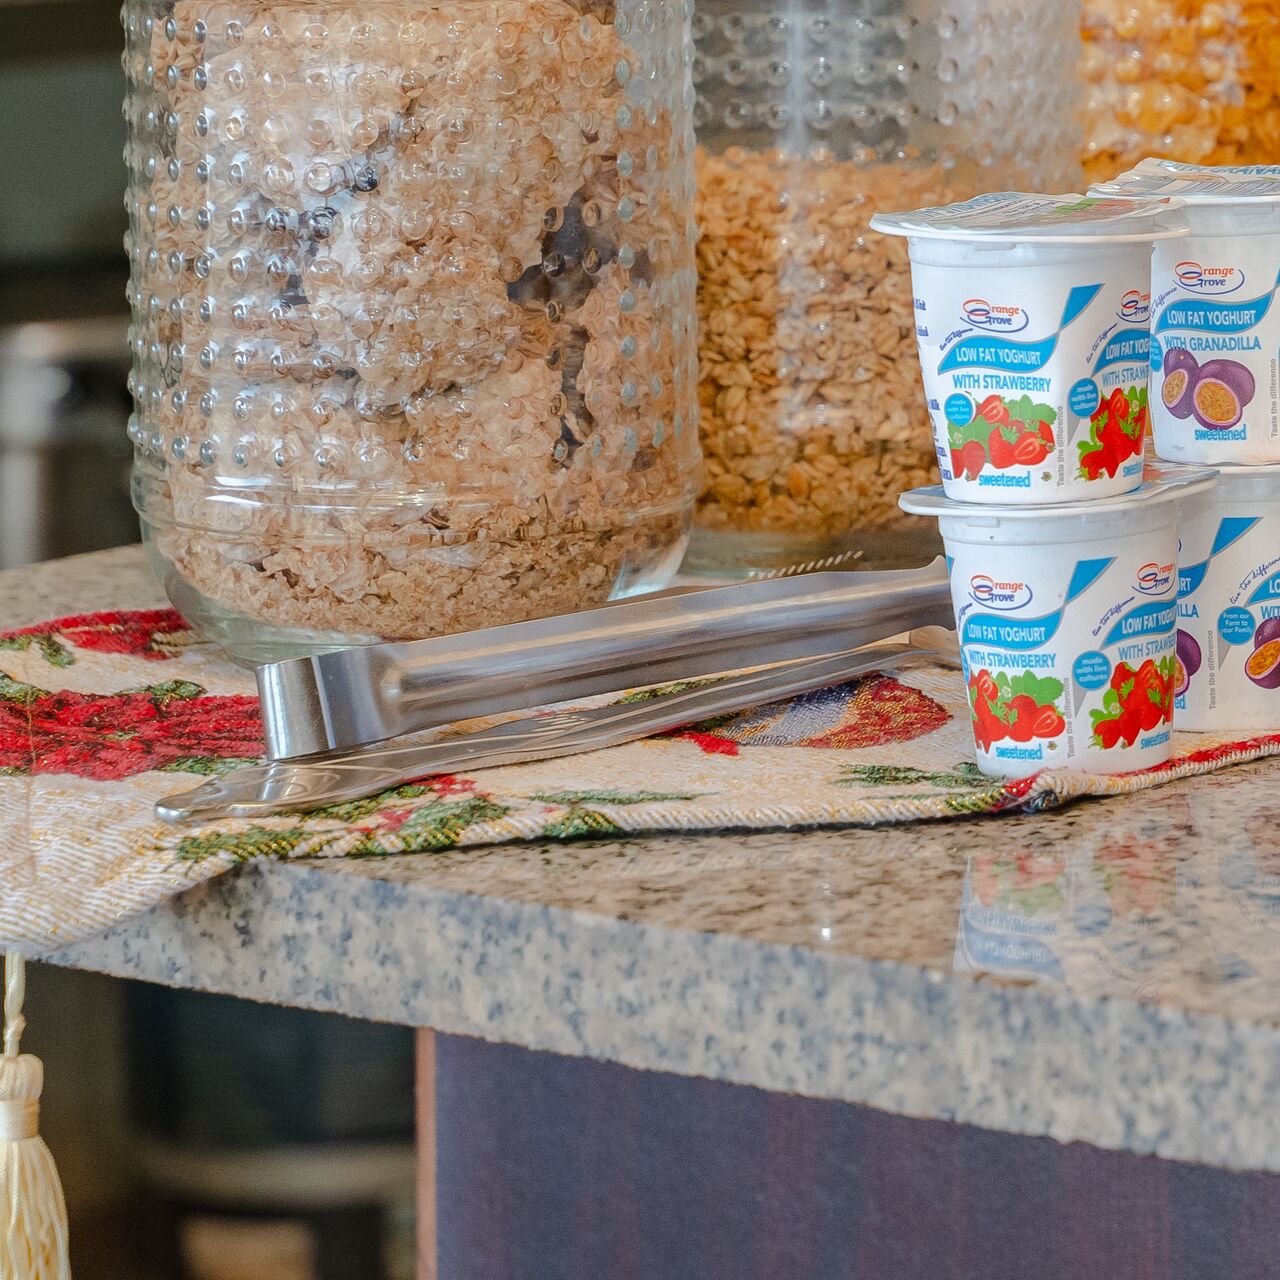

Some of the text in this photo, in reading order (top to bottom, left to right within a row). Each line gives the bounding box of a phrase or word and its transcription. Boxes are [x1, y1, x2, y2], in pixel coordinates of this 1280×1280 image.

[1175, 261, 1234, 279] Orange
[1180, 271, 1226, 288] Grove
[1167, 311, 1186, 324] LOW
[1188, 312, 1204, 325] FAT
[1206, 310, 1256, 325] YOGHURT
[1106, 342, 1120, 360] LOW
[1121, 340, 1134, 356] FAT
[1165, 336, 1186, 350] WITH
[1189, 336, 1262, 351] GRANADILLA
[956, 348, 1041, 365] LOW FAT YOGHURT
[953, 374, 1051, 392] WITH STRAWBERRY
[1102, 370, 1120, 387] WITH
[1194, 424, 1247, 441] sweetened
[979, 471, 1031, 487] sweetened
[971, 575, 1024, 593] Orange
[974, 585, 1015, 602] Grove
[1122, 614, 1158, 634] LOW FAT
[968, 624, 1046, 642] LOW FAT YOGHURT
[968, 649, 1056, 668] WITH STRAWBERRY
[1118, 643, 1144, 661] WITH
[996, 743, 1043, 760] sweetened
